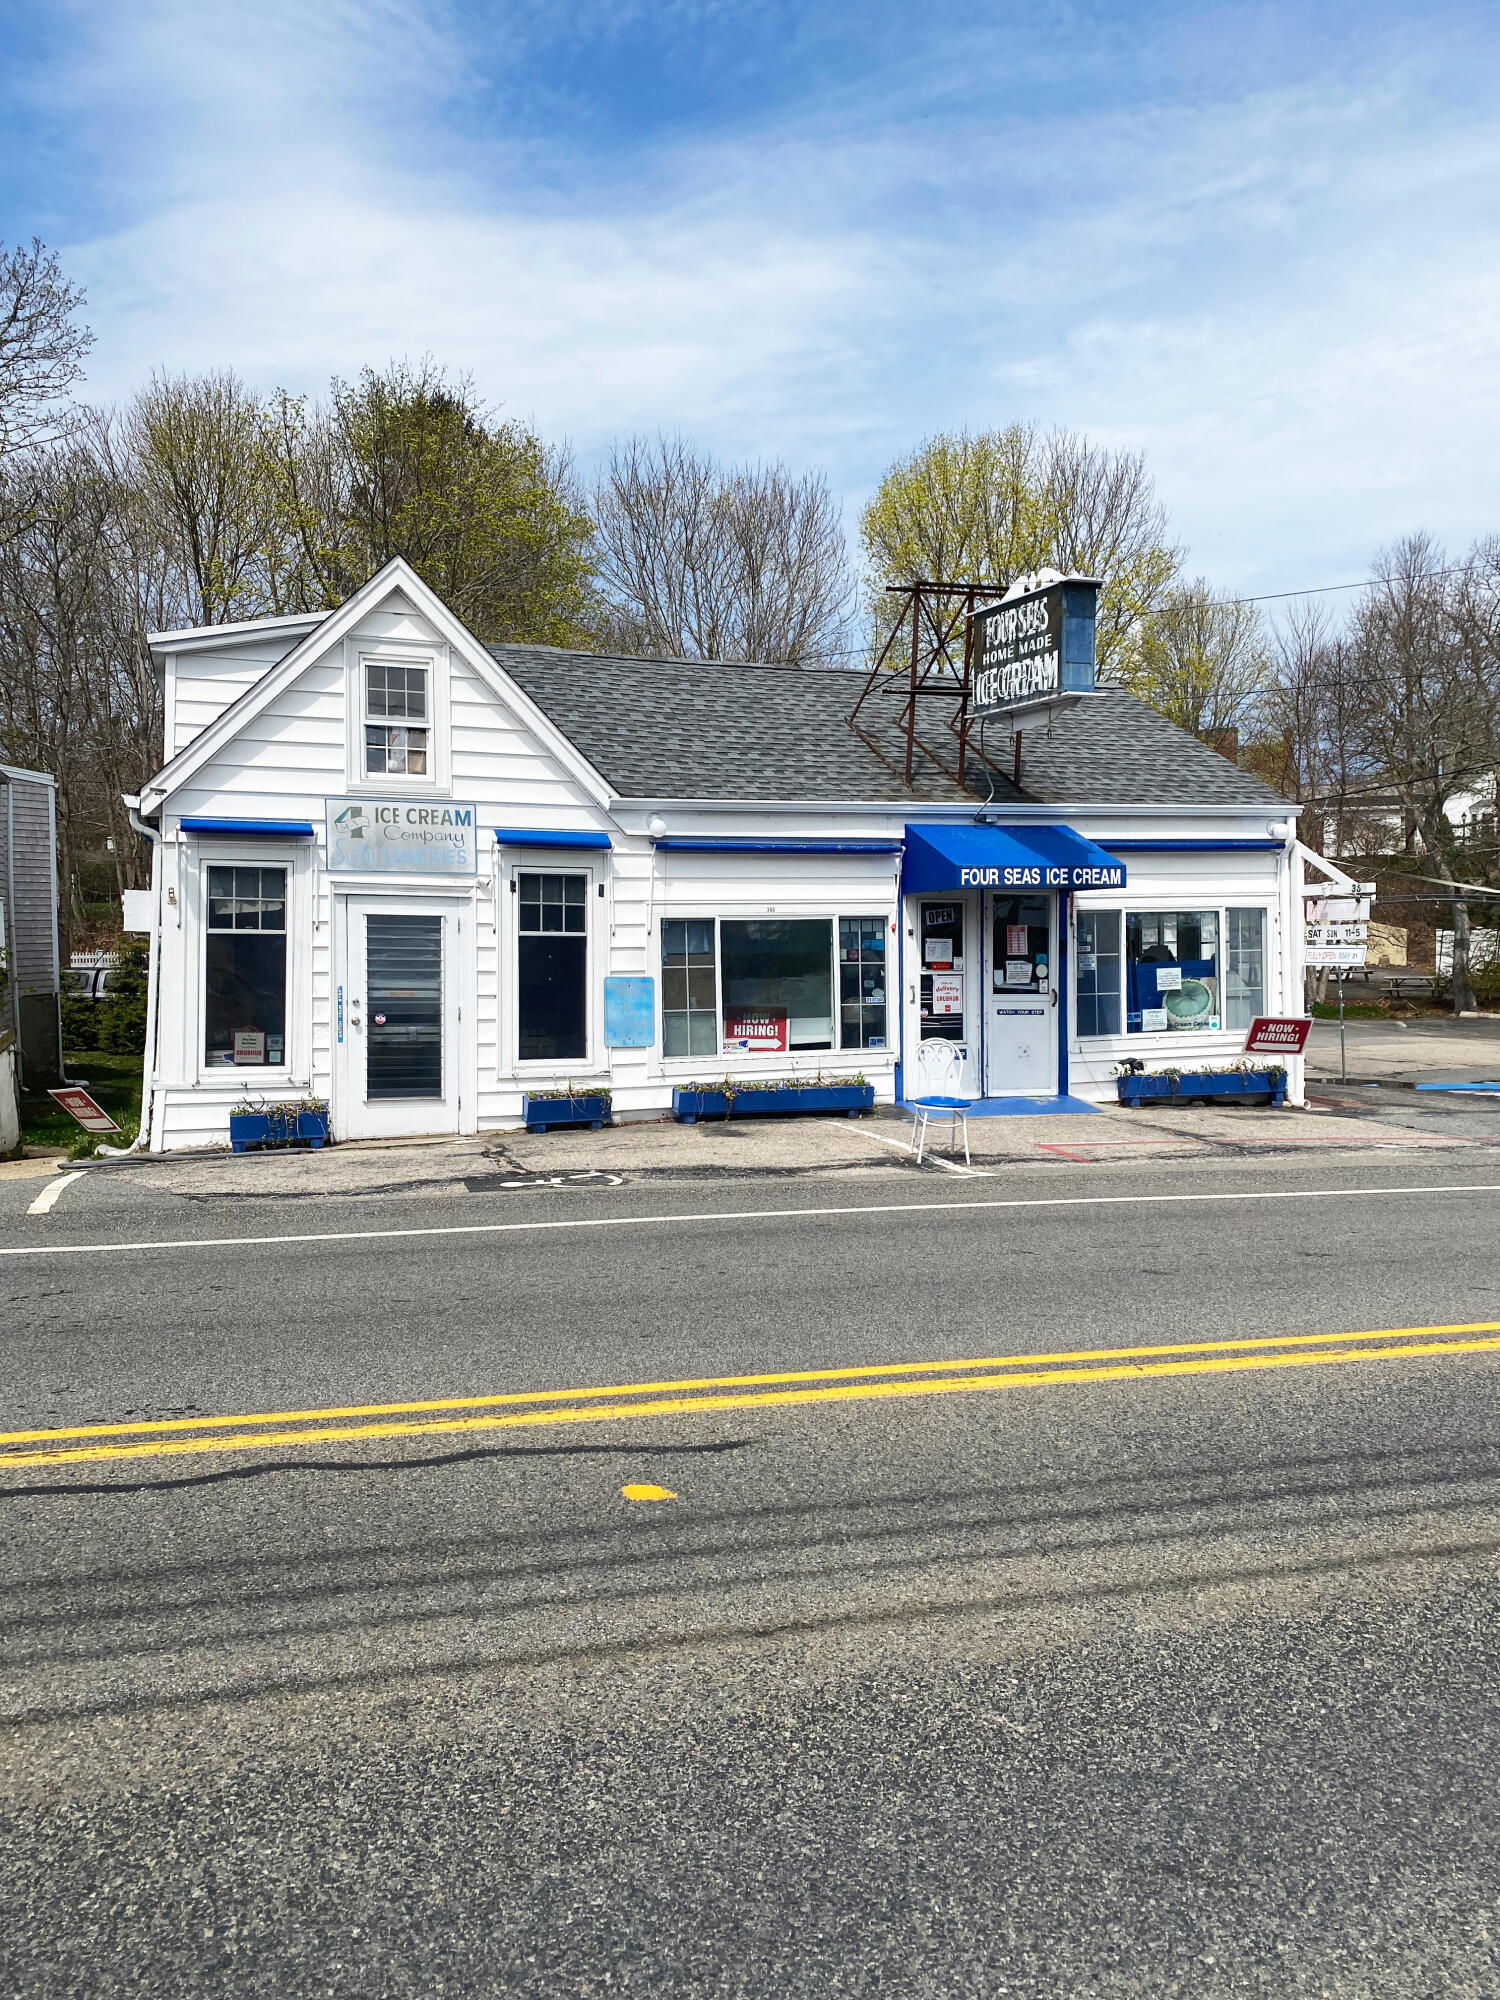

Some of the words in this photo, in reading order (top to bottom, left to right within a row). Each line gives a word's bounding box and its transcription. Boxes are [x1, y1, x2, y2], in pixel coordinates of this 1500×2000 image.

[982, 606, 1017, 648] FOUR
[1017, 596, 1049, 638] SEAS
[982, 645, 1015, 665] HOME
[1018, 633, 1052, 655] MADE
[973, 667, 998, 706] ICE
[997, 650, 1059, 700] CREAM
[375, 807, 400, 824] ICE
[406, 808, 472, 826] CREAM
[383, 825, 465, 848] Company
[382, 848, 468, 865] LUNCHES
[961, 868, 999, 886] FOUR
[1004, 868, 1041, 885] SEAS
[1046, 868, 1069, 885] ICE
[1073, 868, 1122, 885] CREAM
[928, 909, 953, 924] OPEN
[1307, 929, 1322, 939] SAT
[1326, 929, 1338, 938] SUN
[1345, 928, 1361, 938] 11-5
[1322, 951, 1337, 960] OPEN
[1338, 951, 1351, 960] MAY
[935, 985, 960, 993] delivery
[742, 1013, 770, 1024] NOW
[733, 1024, 779, 1036] HIRING!
[1267, 1023, 1295, 1033] NOW
[1256, 1032, 1300, 1042] HIRING!
